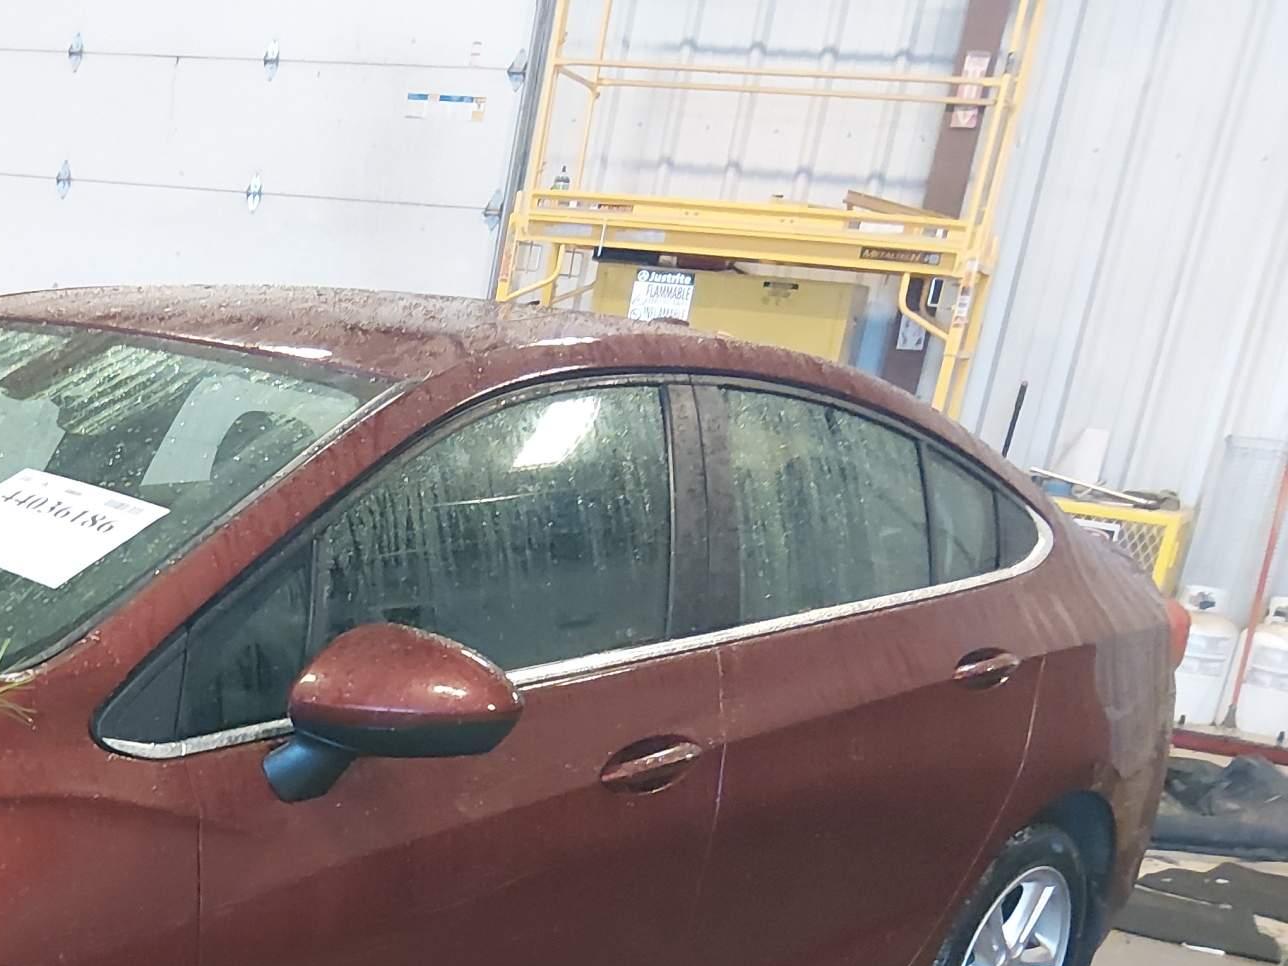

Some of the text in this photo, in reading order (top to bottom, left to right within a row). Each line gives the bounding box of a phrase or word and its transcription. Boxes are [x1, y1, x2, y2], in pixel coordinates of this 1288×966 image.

[648, 271, 692, 285] Justrite
[647, 284, 692, 301] FLAMMABLE
[1, 489, 116, 533] 44036186
